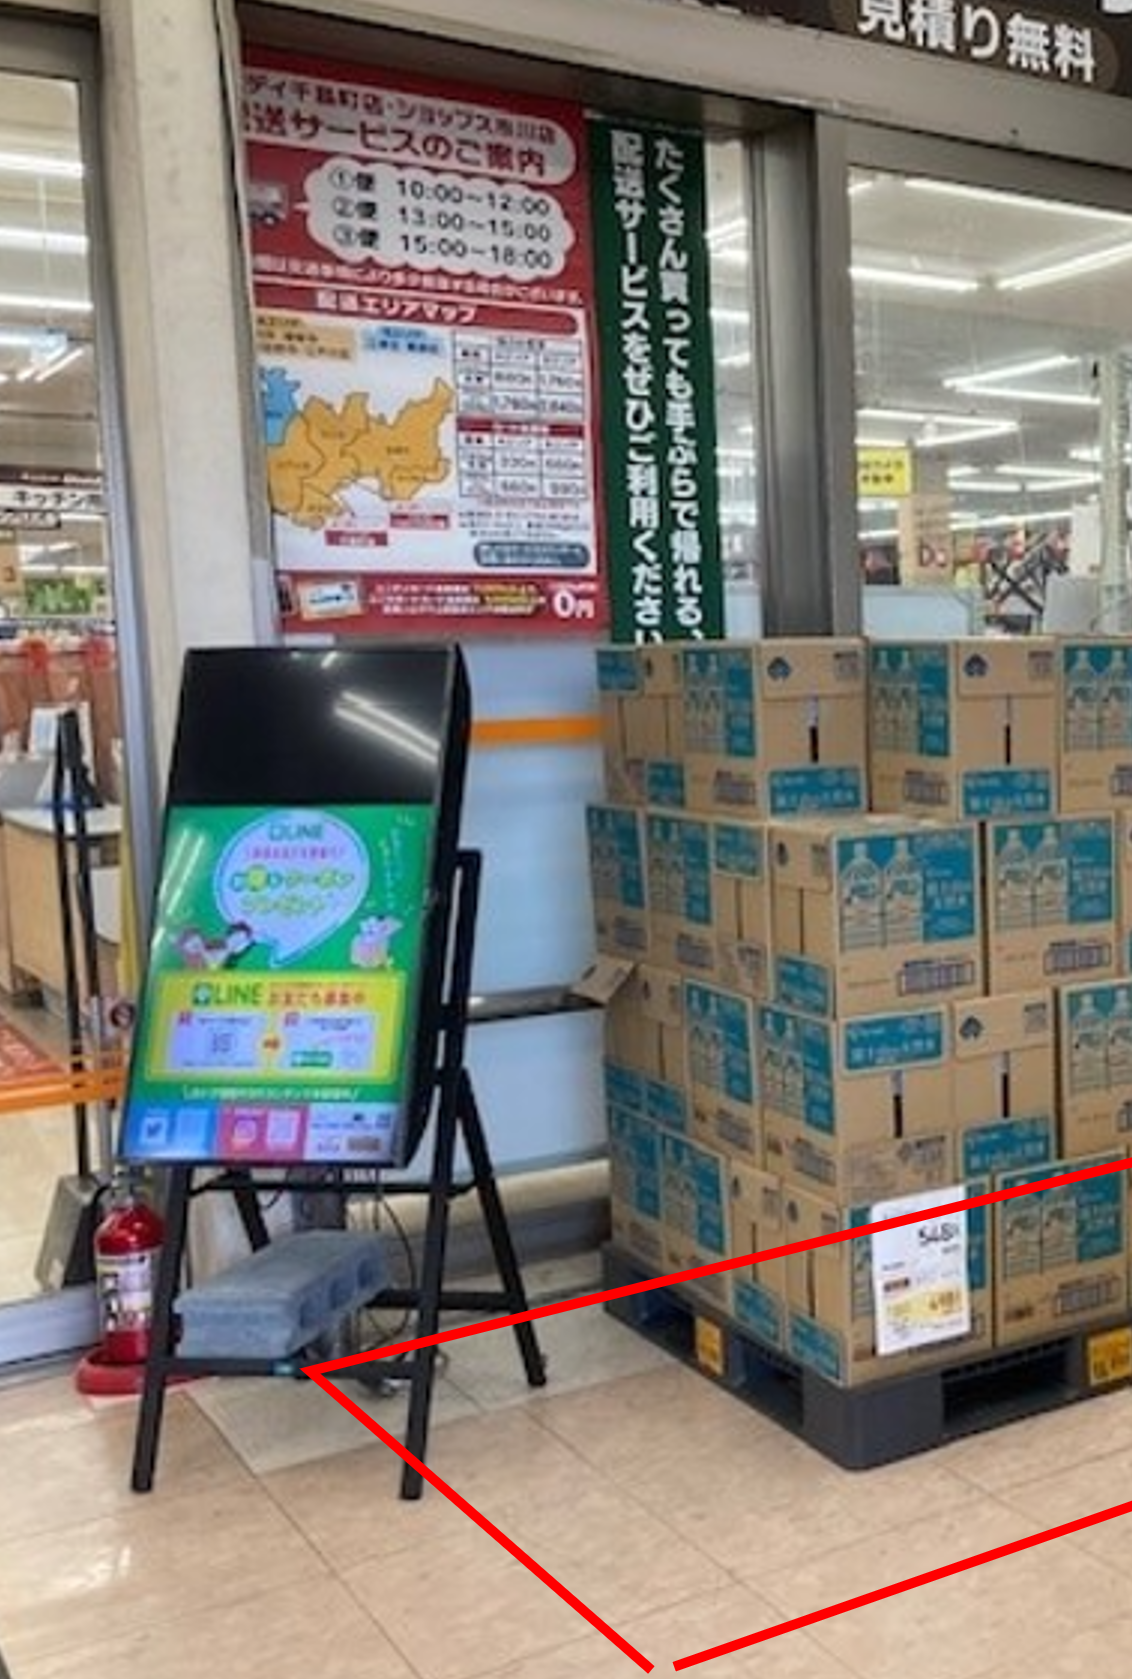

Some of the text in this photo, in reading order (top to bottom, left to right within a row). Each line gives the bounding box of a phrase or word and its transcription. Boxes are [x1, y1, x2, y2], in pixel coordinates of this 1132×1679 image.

[856, 0, 1096, 82] 見積り無料
[214, 982, 263, 1006] LINE
